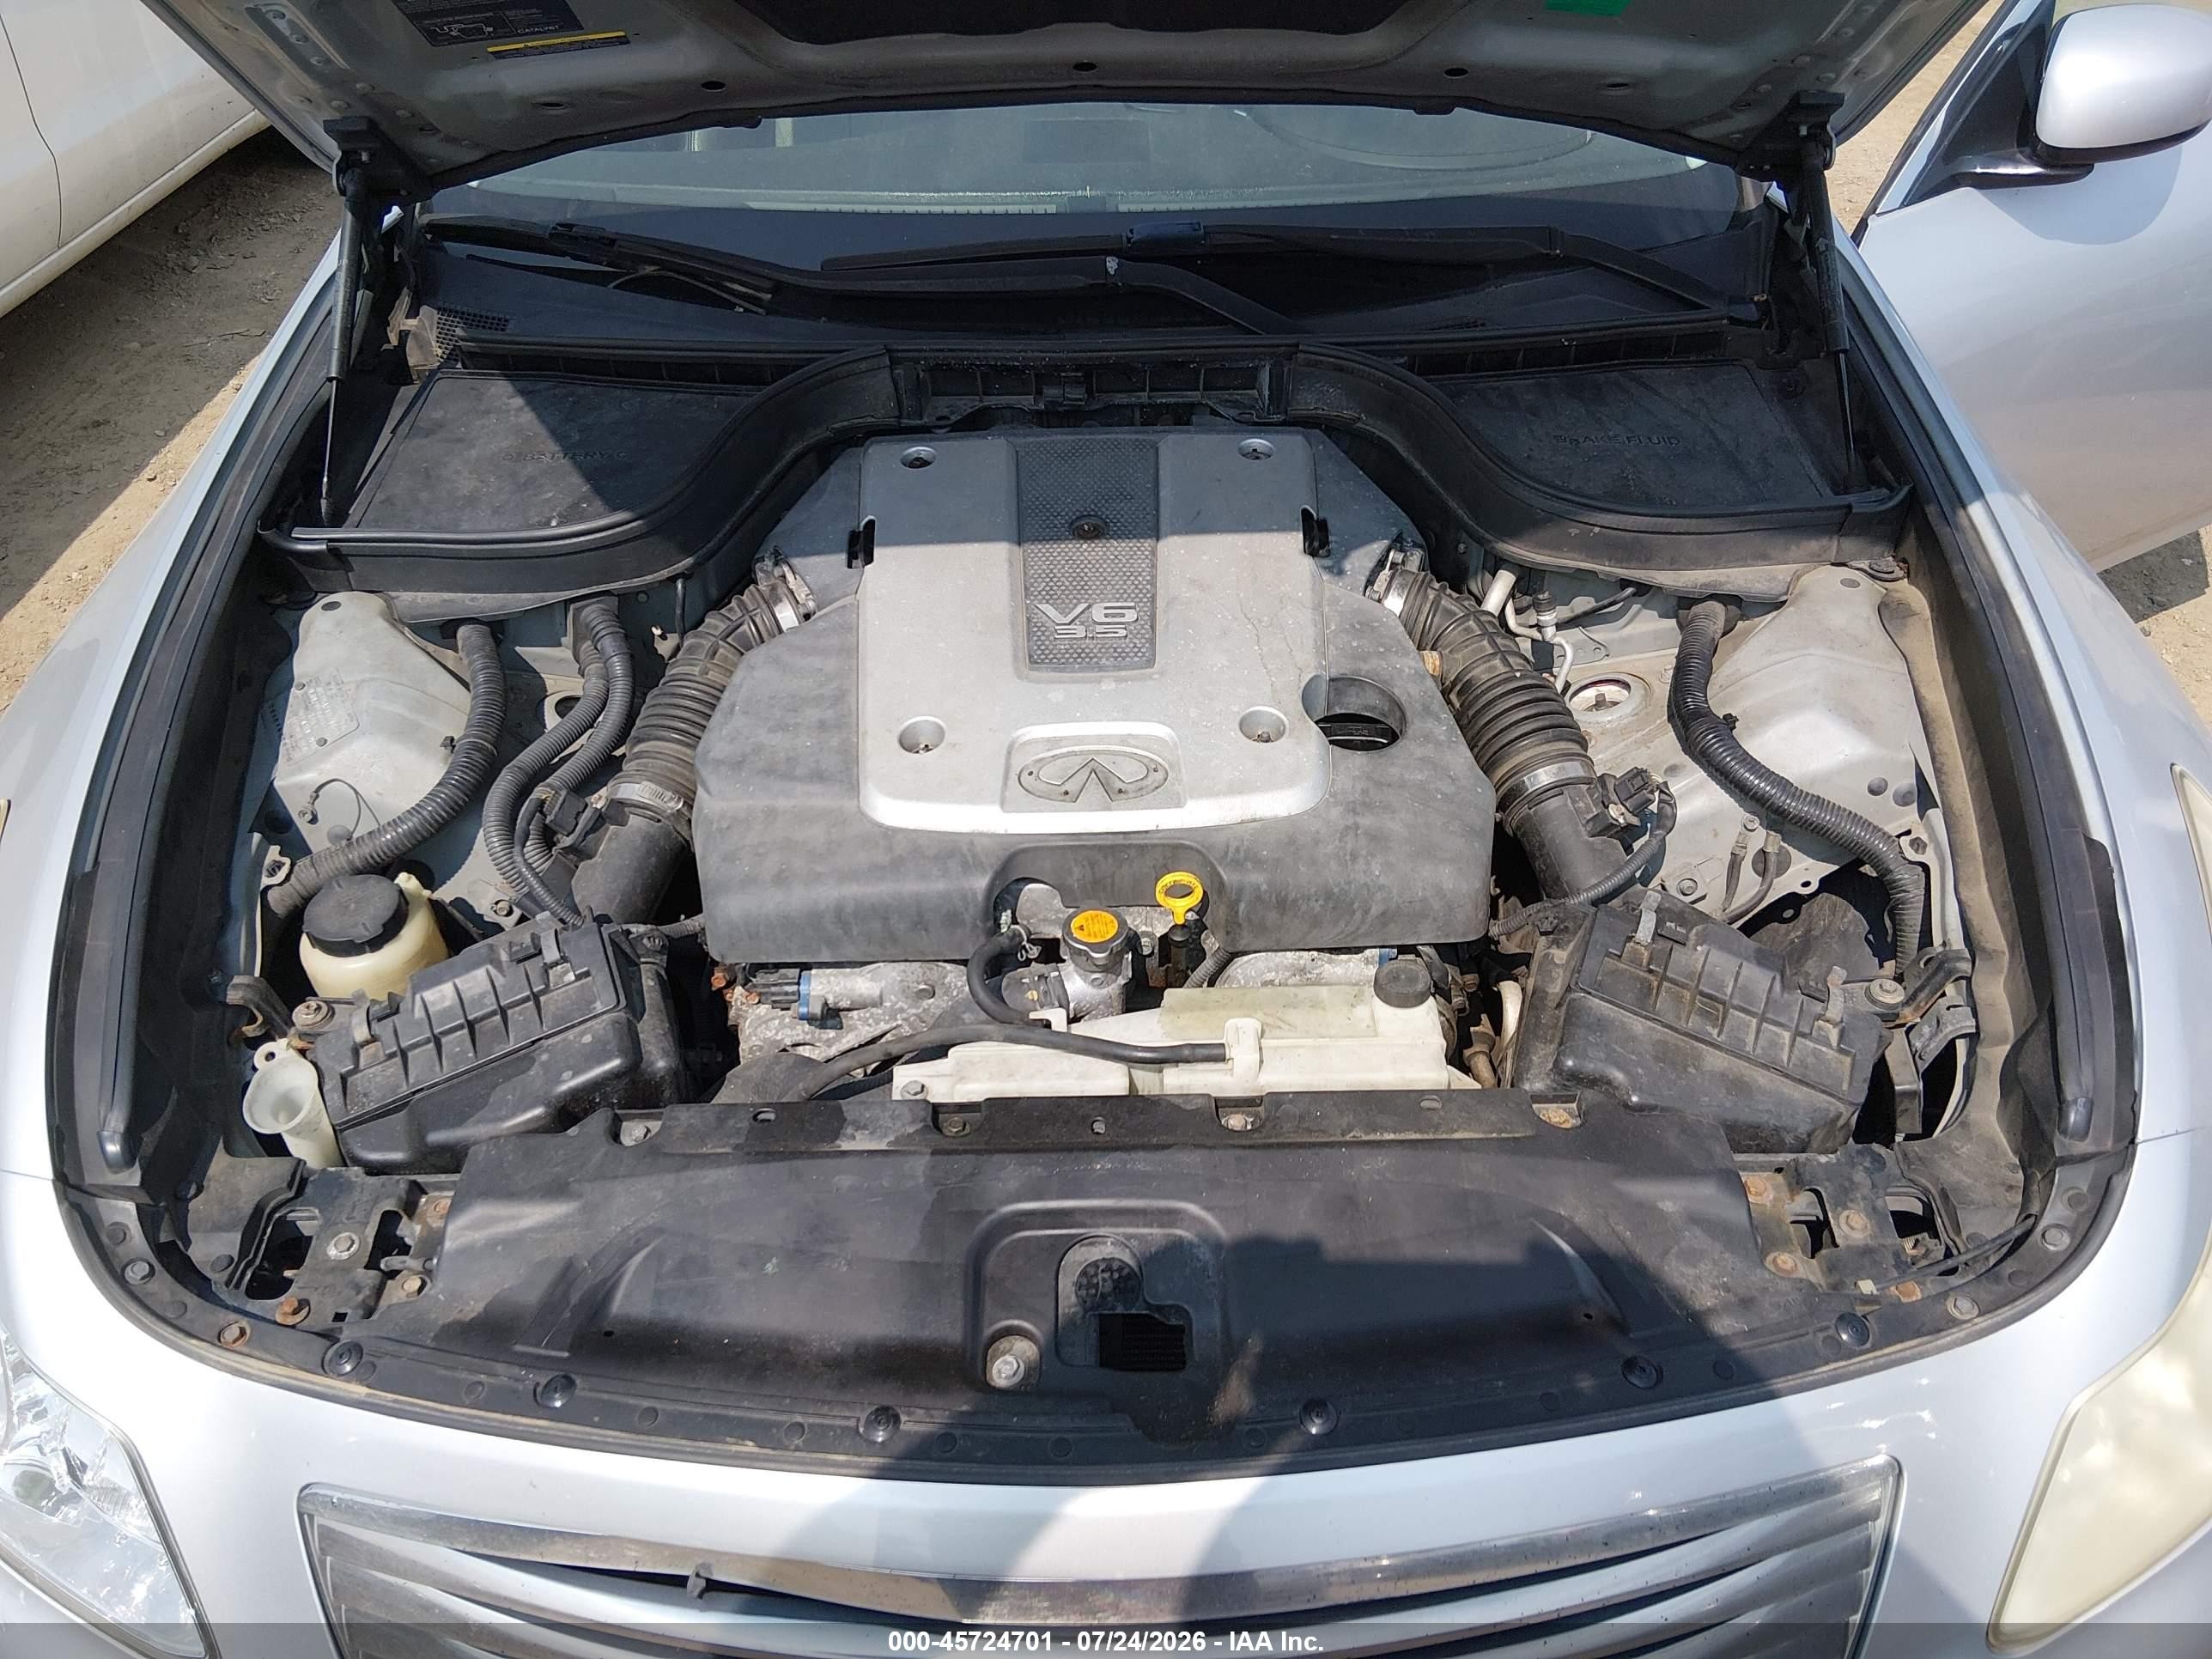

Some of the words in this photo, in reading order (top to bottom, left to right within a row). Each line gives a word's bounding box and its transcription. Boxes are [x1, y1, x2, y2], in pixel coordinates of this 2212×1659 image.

[1625, 434, 1681, 447] FLUID
[1034, 601, 1139, 625] V6
[1054, 624, 1129, 639] 3.5
